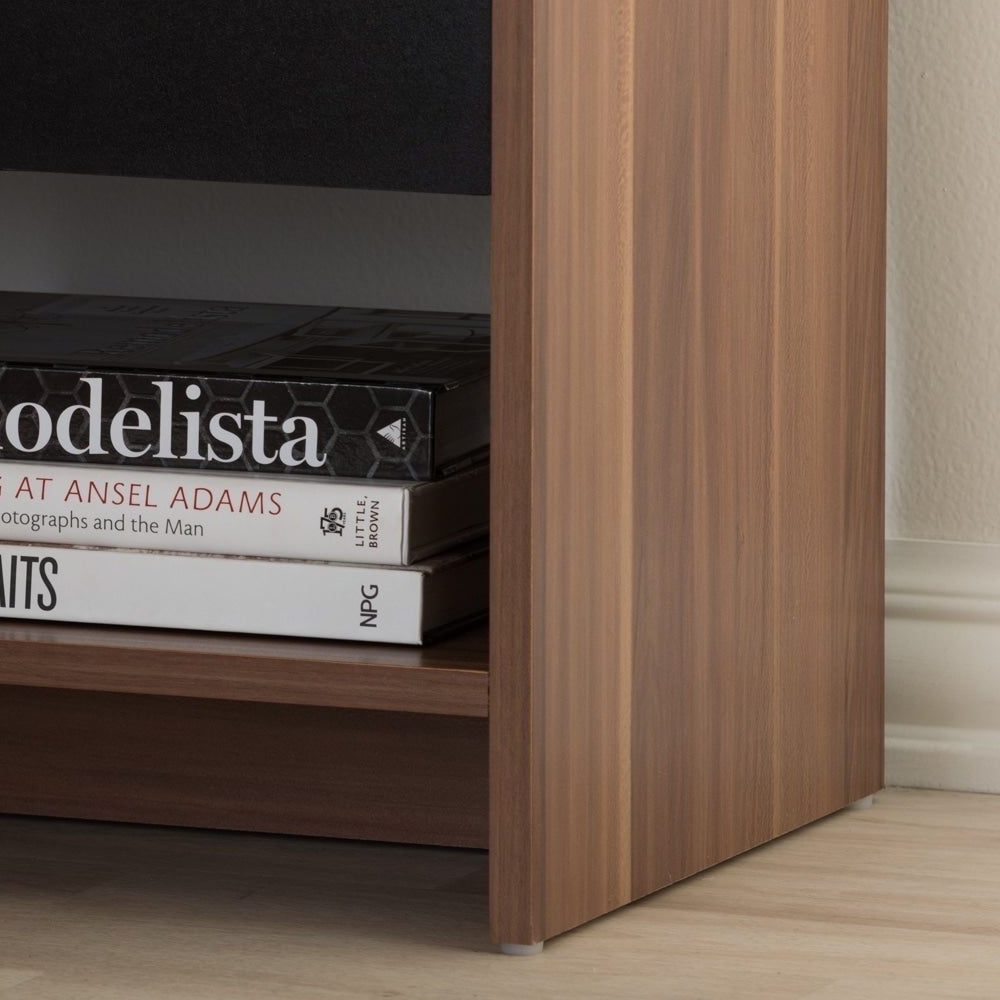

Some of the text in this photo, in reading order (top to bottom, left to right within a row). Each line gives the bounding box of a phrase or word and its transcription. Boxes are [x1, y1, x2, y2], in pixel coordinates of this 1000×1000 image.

[14, 476, 53, 501] AT
[65, 479, 158, 508] ANSEL
[169, 486, 282, 516] ADAMS
[93, 514, 125, 533] and
[131, 515, 159, 535] the
[165, 518, 204, 537] Man
[355, 496, 368, 547] LITTLE,
[369, 500, 380, 548] BROWN
[360, 584, 379, 628] NPG
